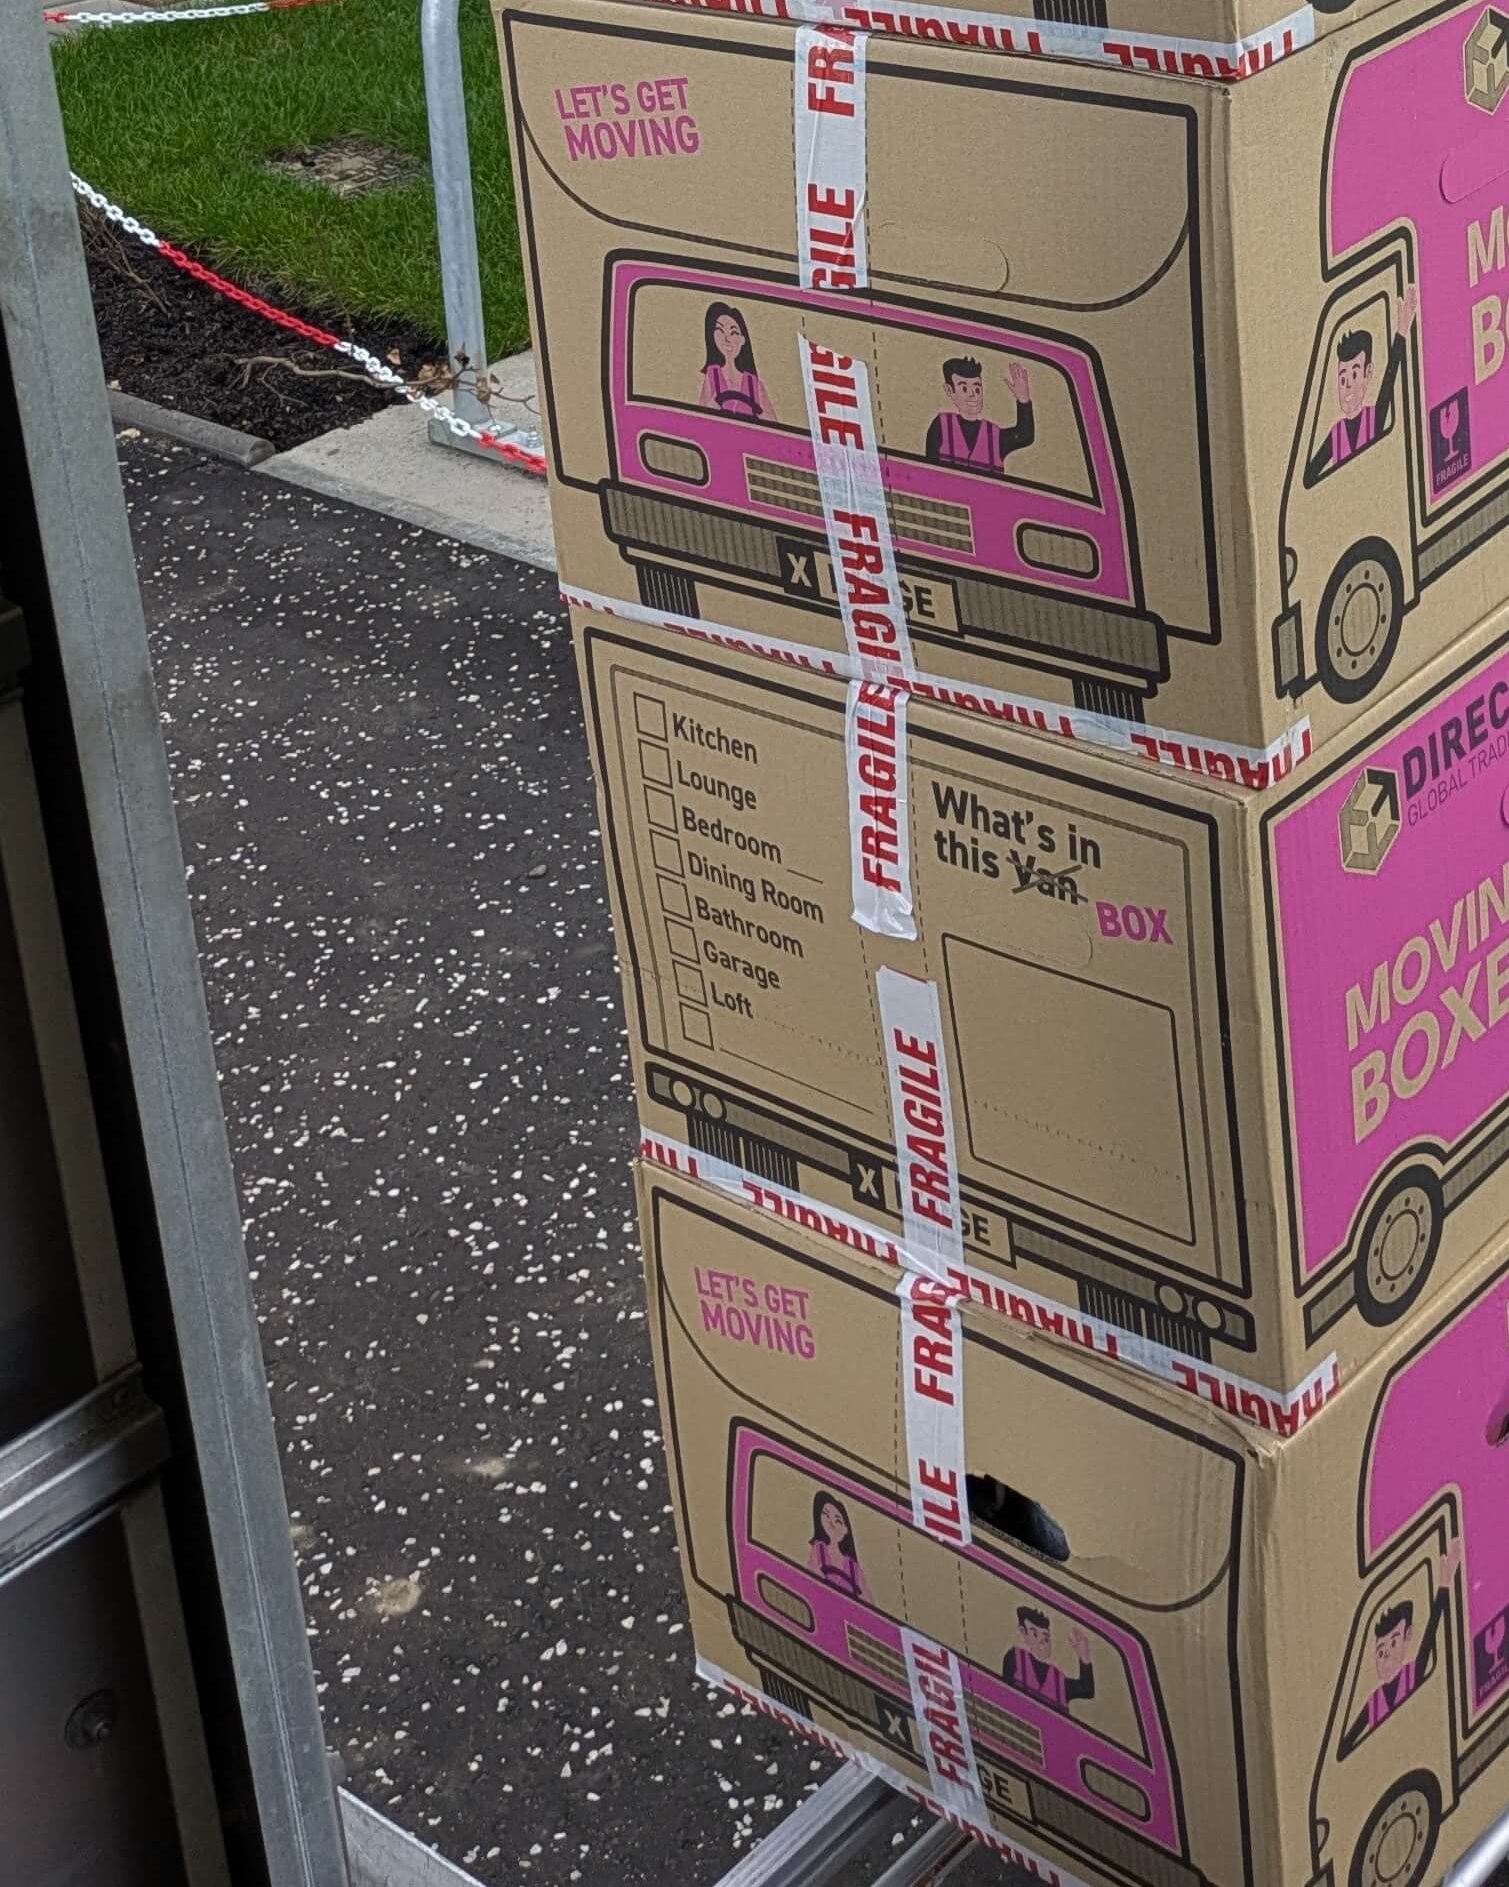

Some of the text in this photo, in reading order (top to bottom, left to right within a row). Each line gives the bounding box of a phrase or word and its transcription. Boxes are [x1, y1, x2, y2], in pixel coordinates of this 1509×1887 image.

[555, 77, 688, 120] LET'S GET
[564, 115, 699, 161] MOVING
[1436, 457, 1469, 487] FRAGILE
[786, 552, 812, 587] X
[672, 713, 758, 764] Kitchen
[676, 760, 757, 811] Lounge
[857, 675, 902, 894] FRAGILE
[1407, 769, 1467, 825] GLOBAL
[682, 806, 782, 864] Bedroom
[931, 781, 1101, 869] What's in
[687, 851, 824, 923] Dining Room
[934, 829, 1078, 905] this Van
[694, 896, 804, 958] Bathroom
[1095, 901, 1174, 945] BOX
[703, 940, 780, 990] Garage
[710, 982, 754, 1018] Loft
[894, 1027, 953, 1229] FRAGILE
[857, 1163, 879, 1200] X
[694, 1266, 809, 1320] LET'S GET
[701, 1299, 816, 1360] MOVING
